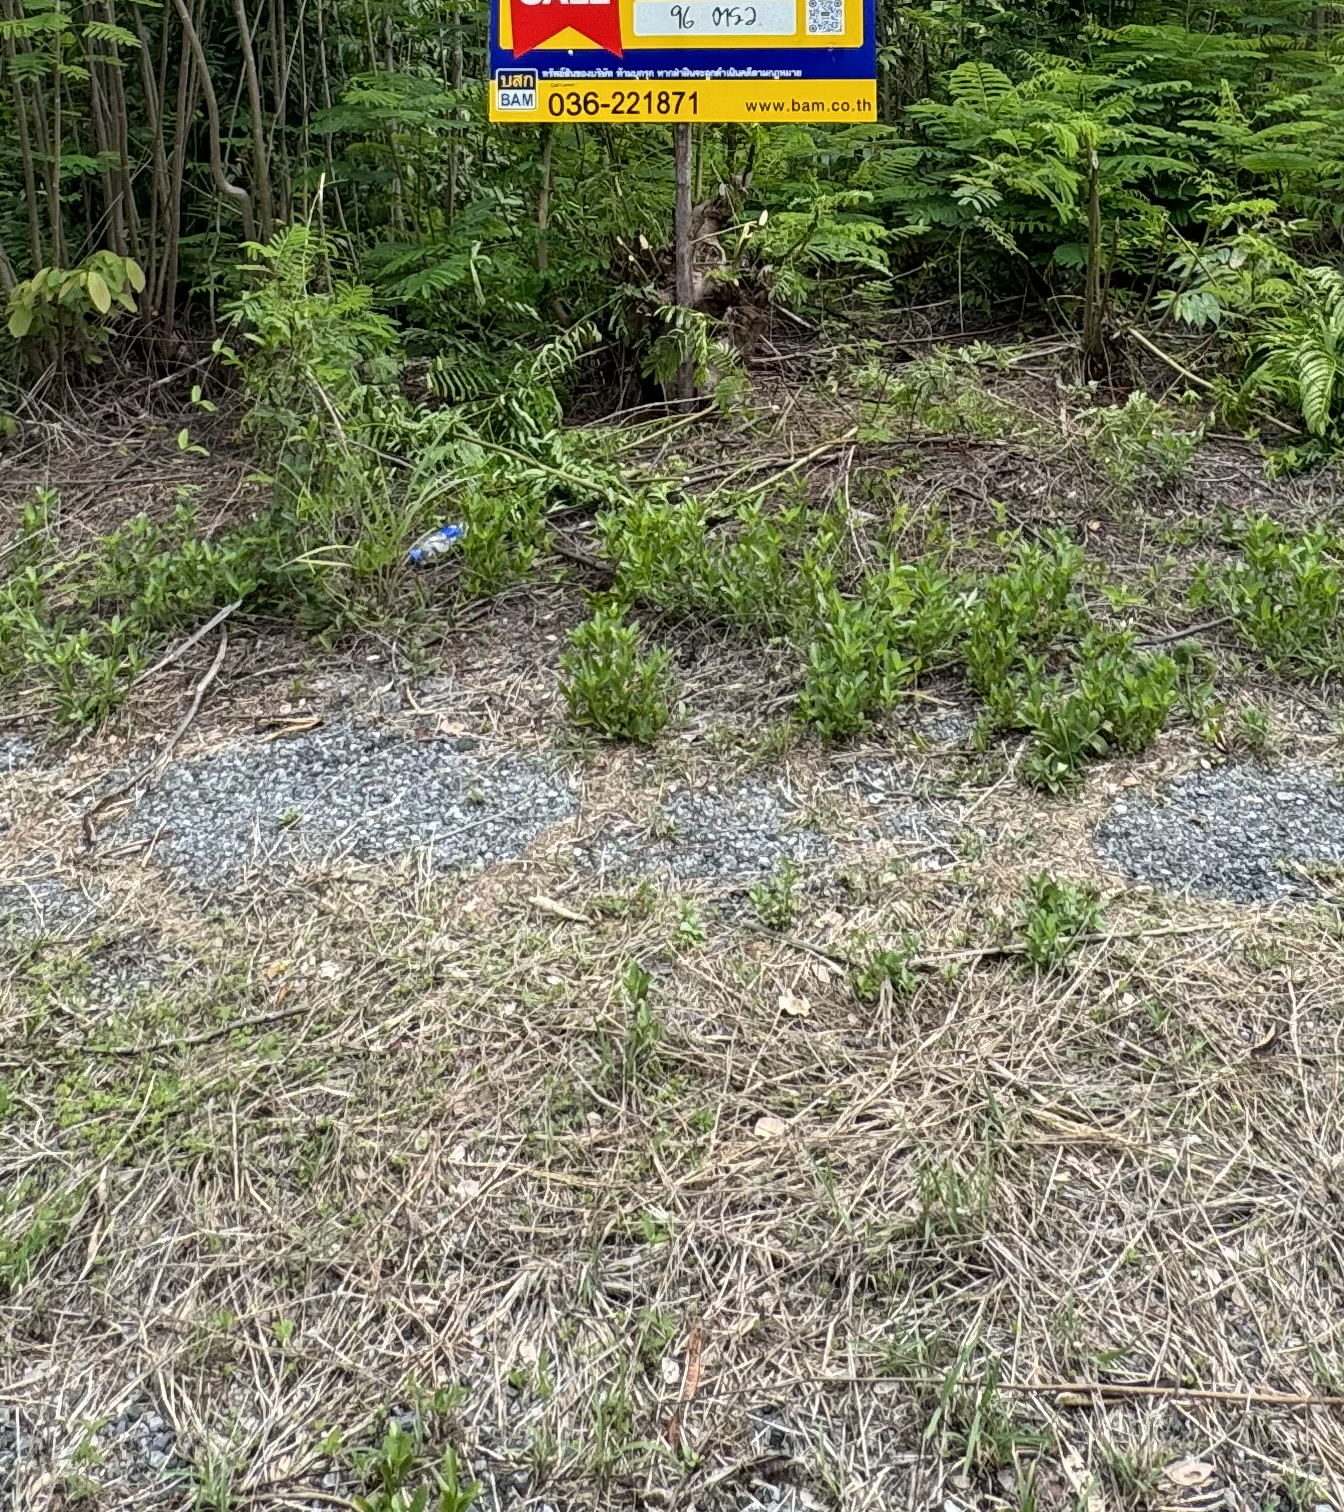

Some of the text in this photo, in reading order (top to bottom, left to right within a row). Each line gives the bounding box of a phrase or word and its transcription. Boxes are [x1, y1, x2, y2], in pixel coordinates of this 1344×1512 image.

[670, 5, 695, 30] 96
[500, 74, 534, 88] บสก
[500, 93, 534, 107] BAM
[548, 91, 698, 117] 036-221871
[745, 98, 872, 113] www.bam.co.th
